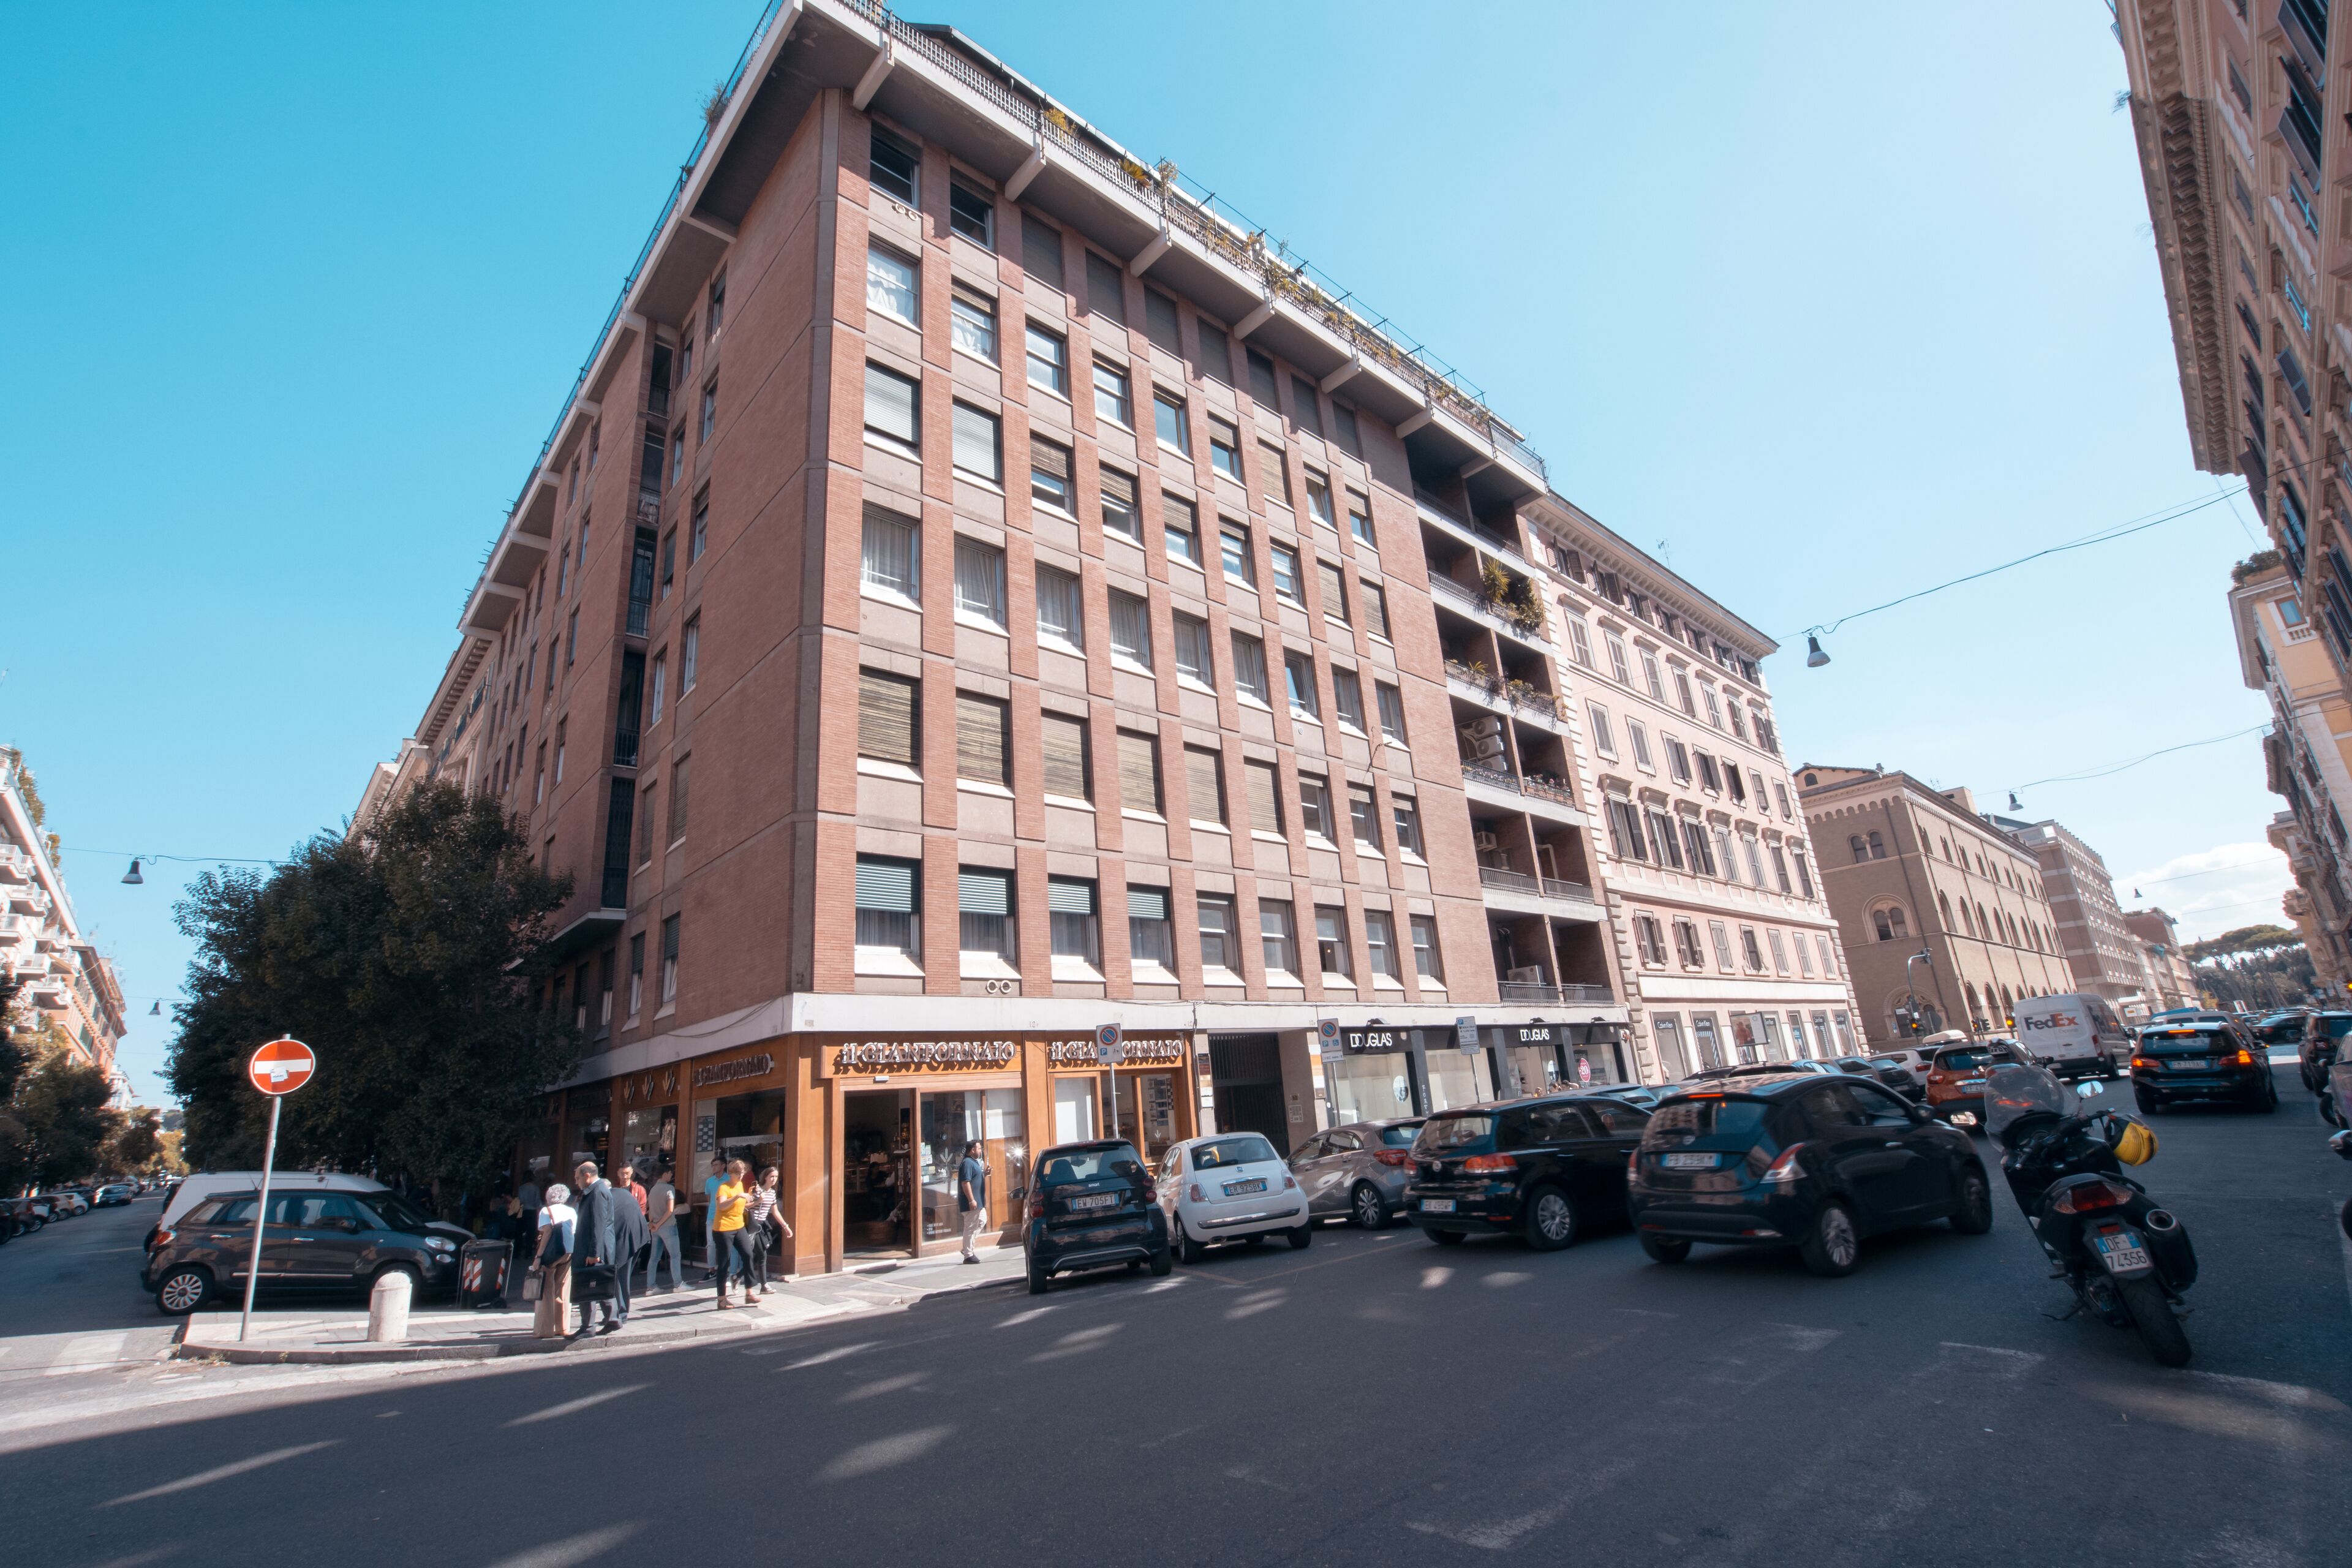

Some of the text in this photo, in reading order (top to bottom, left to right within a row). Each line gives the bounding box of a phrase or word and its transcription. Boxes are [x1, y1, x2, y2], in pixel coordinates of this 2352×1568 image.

[2024, 1013, 2079, 1030] FedEx
[1350, 1033, 1392, 1047] DOUGLAS
[1520, 1029, 1550, 1041] DOUGLAS
[861, 1041, 1017, 1063] GIANFORNAIO
[1240, 1182, 1261, 1192] 925BK
[1078, 1195, 1113, 1208] EW 705FT
[2105, 1237, 2119, 1250] DF
[2106, 1251, 2147, 1269] 74356
